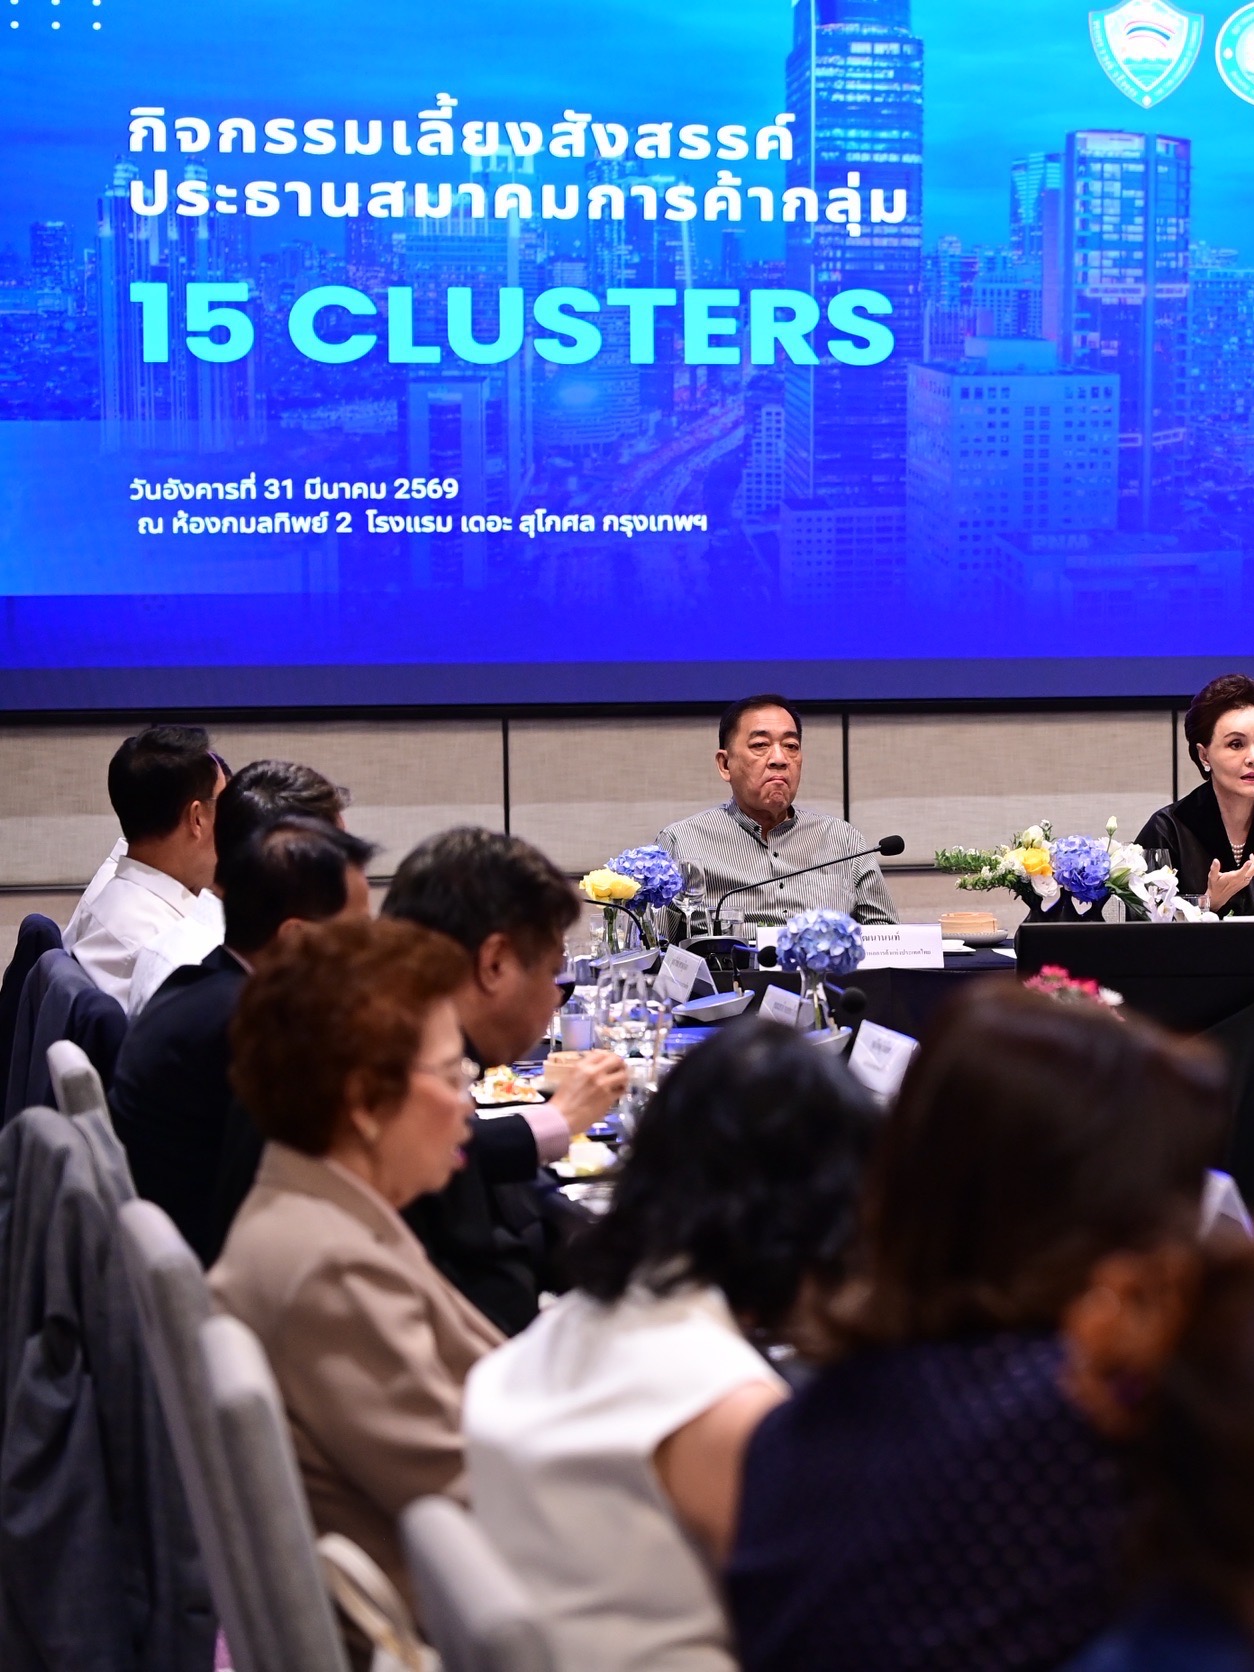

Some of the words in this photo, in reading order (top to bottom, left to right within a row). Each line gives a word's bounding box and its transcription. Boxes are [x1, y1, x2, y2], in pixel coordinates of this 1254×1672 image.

[129, 93, 796, 160] กิจกรรมเลี้ยงสังสรรค์
[130, 170, 908, 237] ประธานสมาคมการค้ากลุ่ม
[130, 282, 254, 364] 15
[288, 286, 896, 366] CLUSTERS
[130, 471, 257, 500] วันอังคารที่
[264, 478, 293, 500] 31
[304, 476, 387, 500] มีนาคม
[393, 478, 459, 499] 2569
[138, 517, 163, 534] ณ
[172, 510, 329, 534] ห้องกมลทิพย์
[335, 512, 352, 533] 2
[366, 511, 453, 533] โรงแรม
[461, 515, 513, 533] เดอะ
[519, 510, 595, 538] สุโกศล
[602, 514, 709, 538] กรุงเทพฯ
